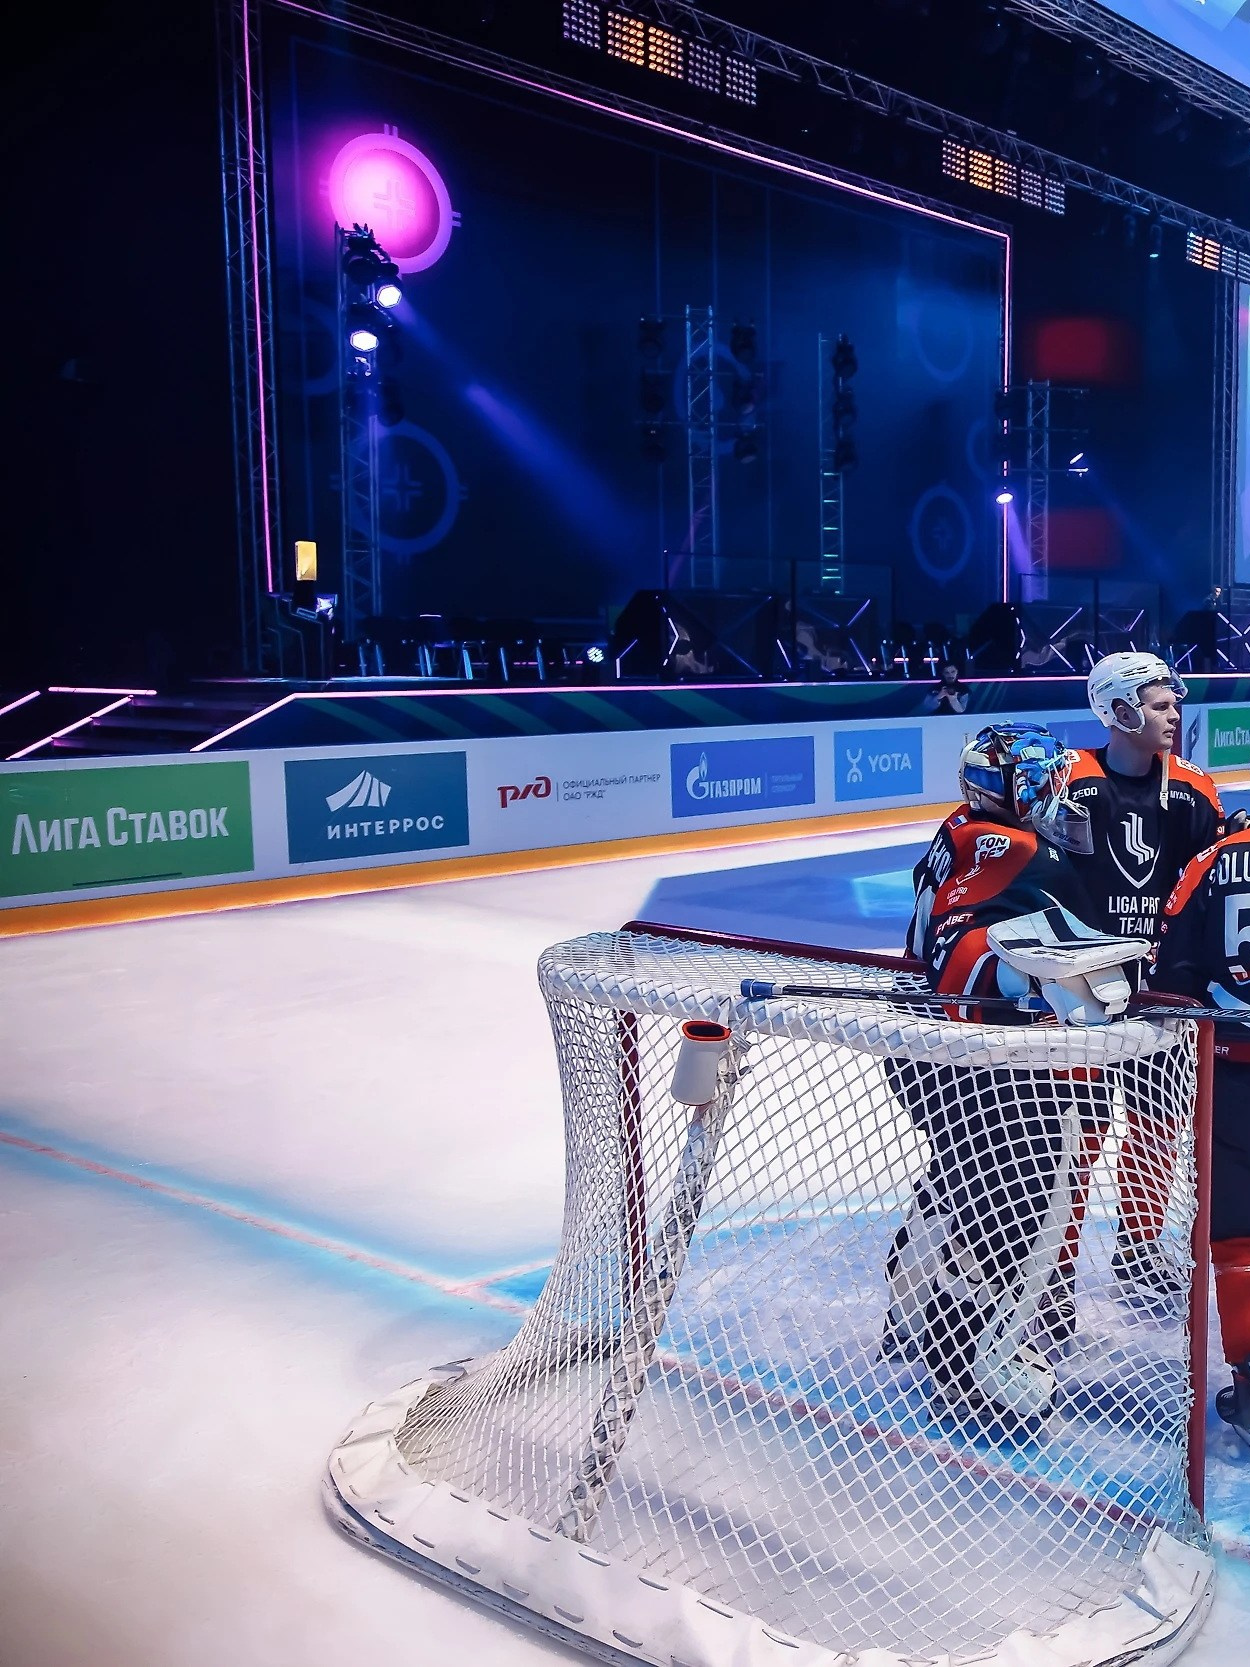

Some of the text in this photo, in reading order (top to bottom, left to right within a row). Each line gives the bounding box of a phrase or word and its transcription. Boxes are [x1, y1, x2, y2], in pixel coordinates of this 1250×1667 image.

[867, 753, 912, 773] YOTA
[562, 773, 661, 790] ОФИЦИАЛЬНЫЙ ПАРТНЕР
[708, 777, 762, 799] ГАЗПРОМ
[326, 815, 445, 841] ИНТЕРРОС
[1108, 896, 1139, 914] LIGA
[1119, 916, 1155, 936] TEAM
